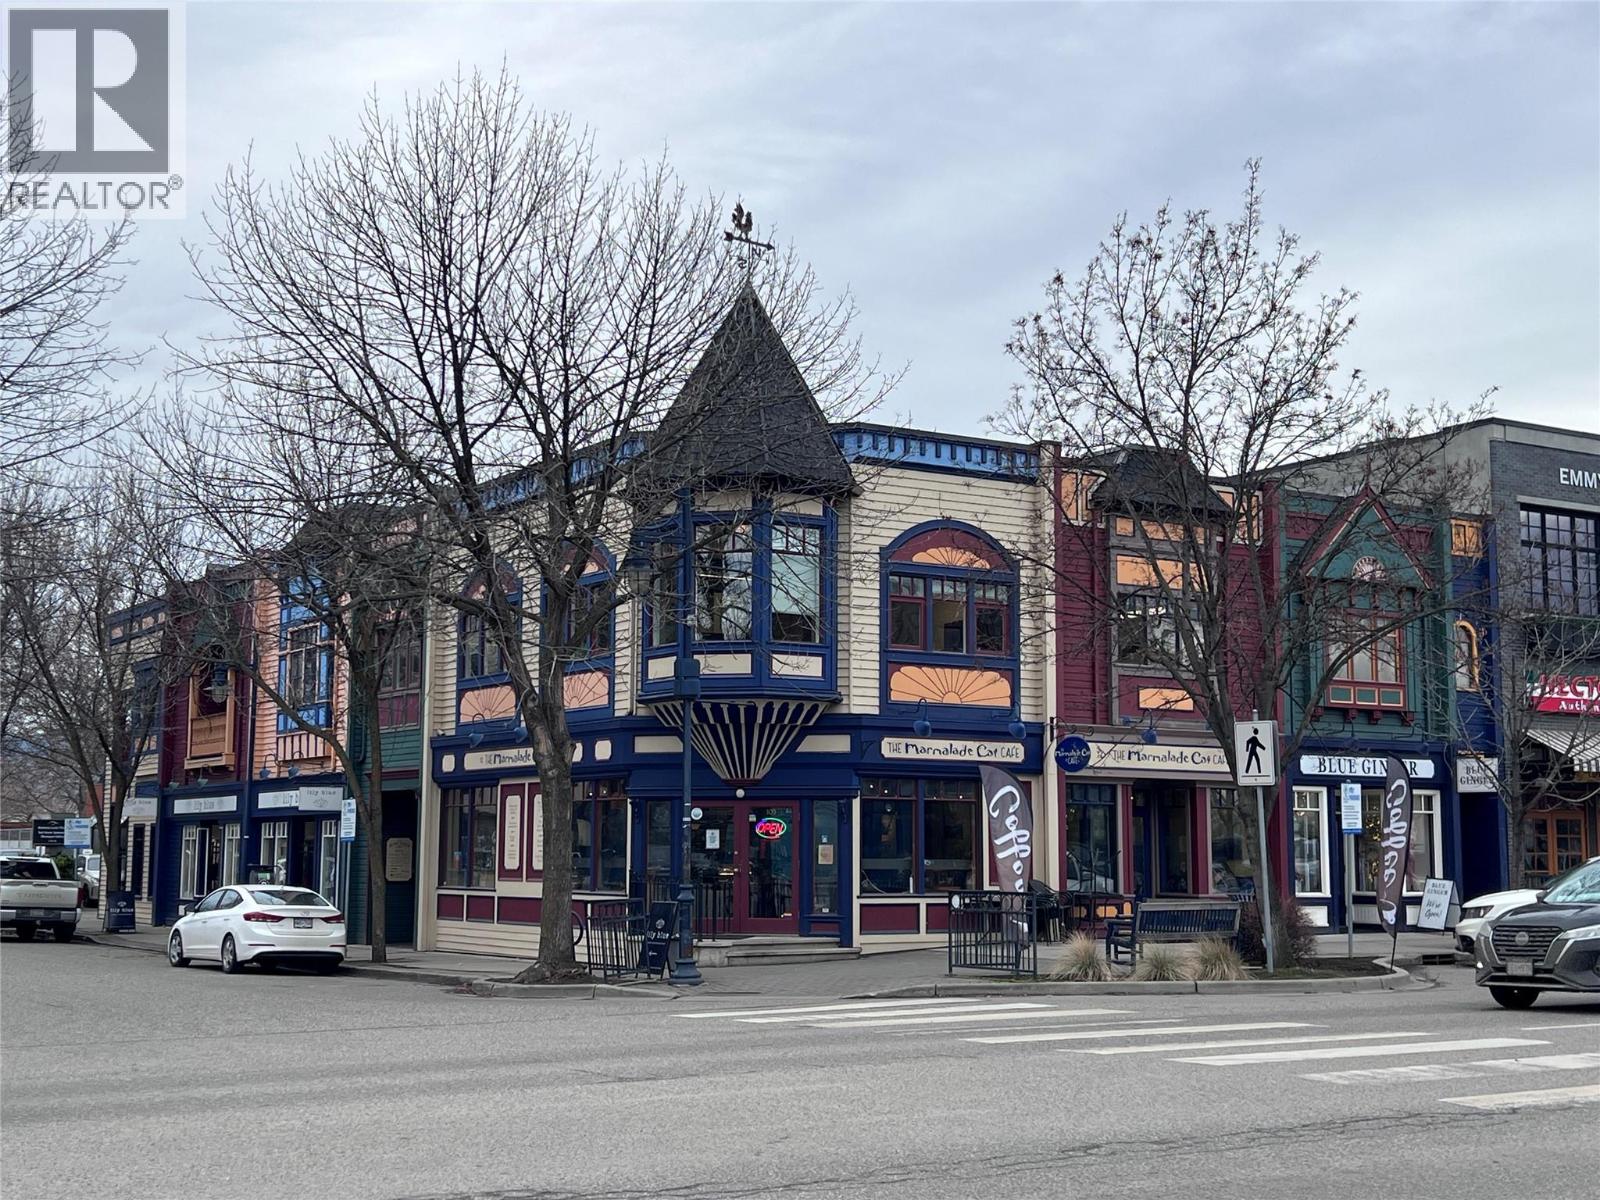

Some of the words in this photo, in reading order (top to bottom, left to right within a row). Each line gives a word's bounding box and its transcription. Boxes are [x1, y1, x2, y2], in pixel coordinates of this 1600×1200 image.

[1559, 700, 1600, 712] Authn
[493, 749, 532, 765] Marmalade
[886, 741, 902, 754] THE
[904, 742, 974, 757] Marmalade
[977, 743, 998, 758] Cat
[1112, 749, 1126, 761] THE
[1127, 750, 1189, 764] Marmalade
[1191, 752, 1211, 765] Cat
[1318, 757, 1357, 774] BLUE
[1362, 758, 1418, 776] GINR
[757, 822, 784, 835] OPEN
